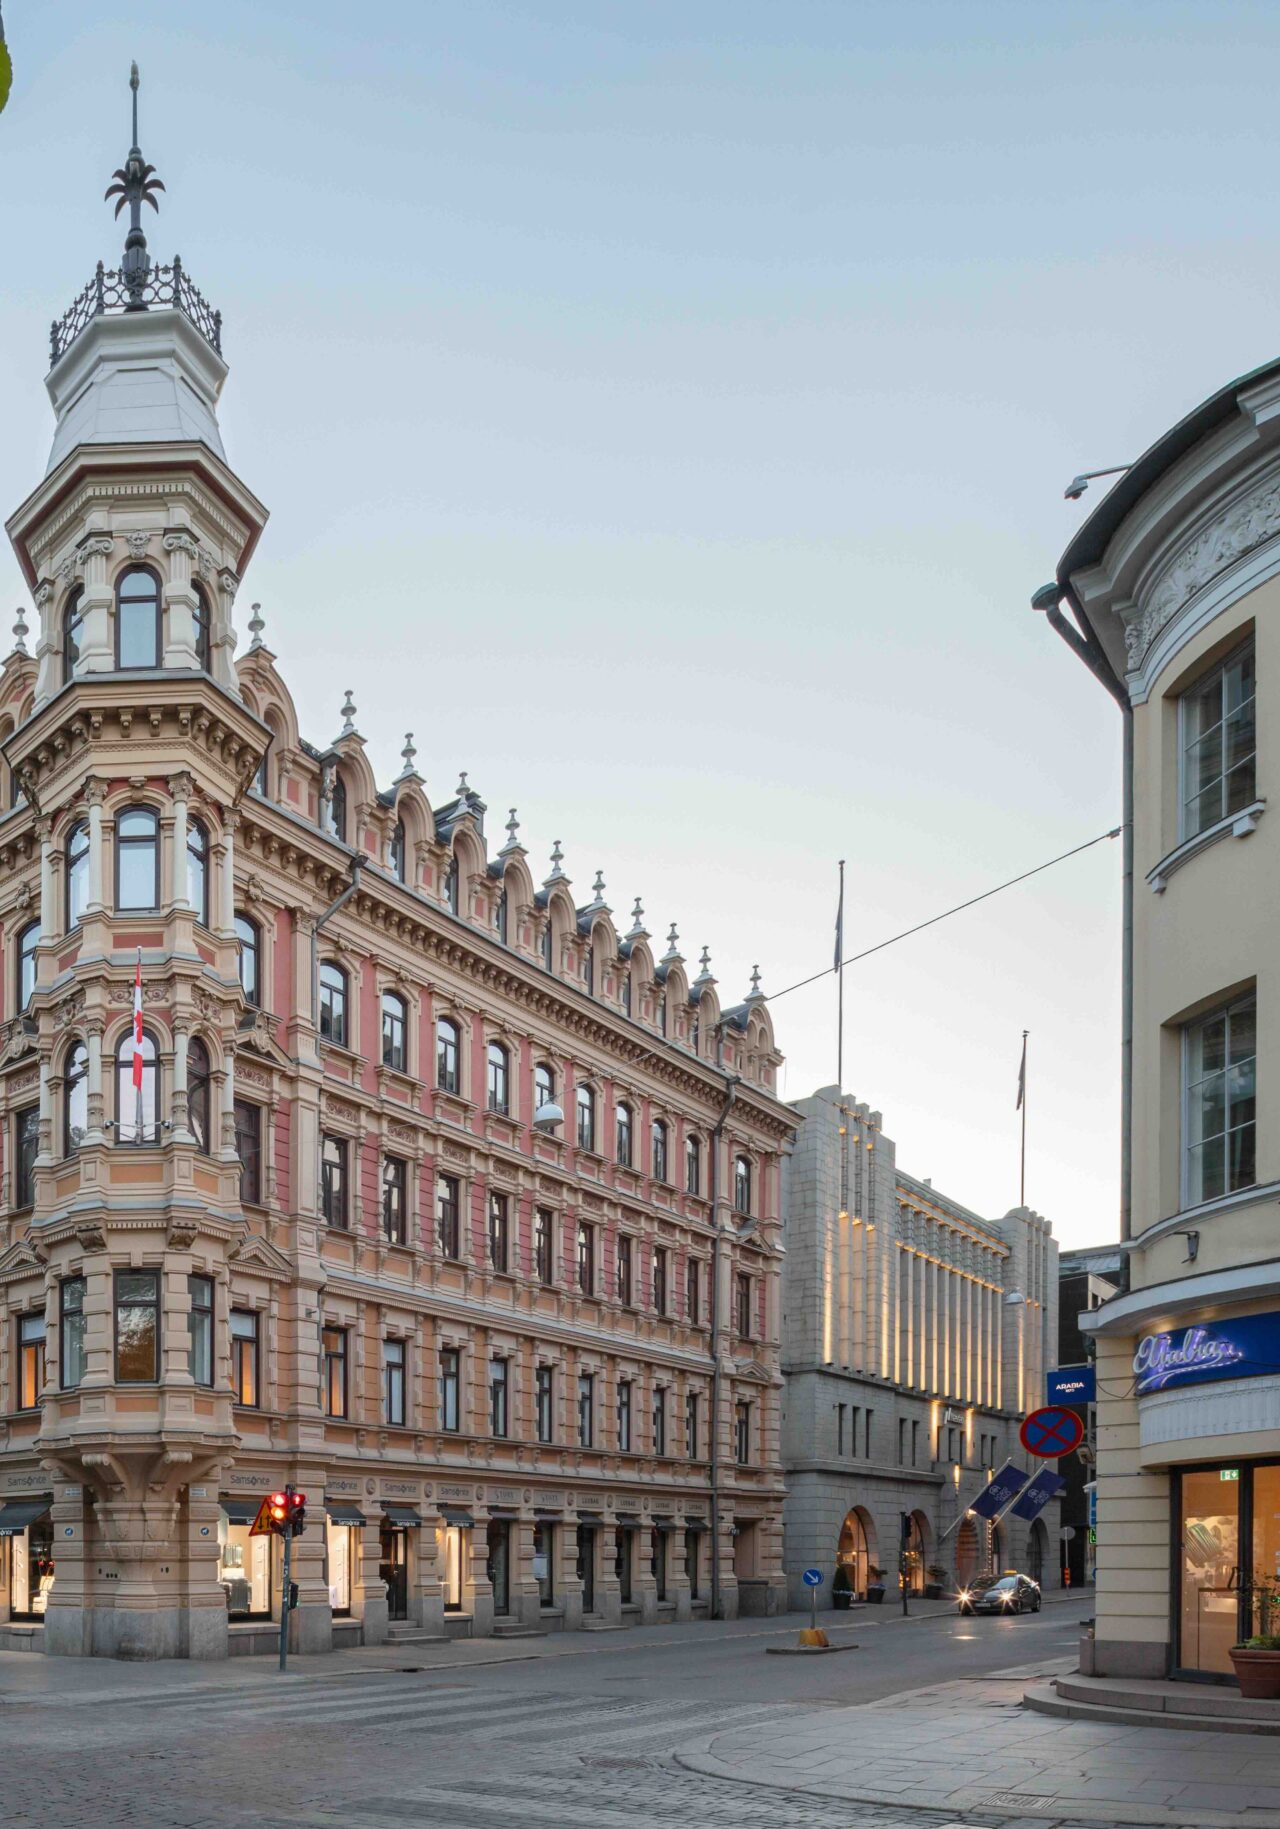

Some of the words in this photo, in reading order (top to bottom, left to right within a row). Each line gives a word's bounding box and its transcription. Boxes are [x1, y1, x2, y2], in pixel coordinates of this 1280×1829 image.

[1132, 1327, 1230, 1388] Arabia
[1056, 1382, 1084, 1390] ARABIA
[7, 1475, 47, 1487] Samsonite
[230, 1474, 270, 1486] Samsonite
[325, 1480, 358, 1490] amsonite
[384, 1483, 417, 1493] Samsonite
